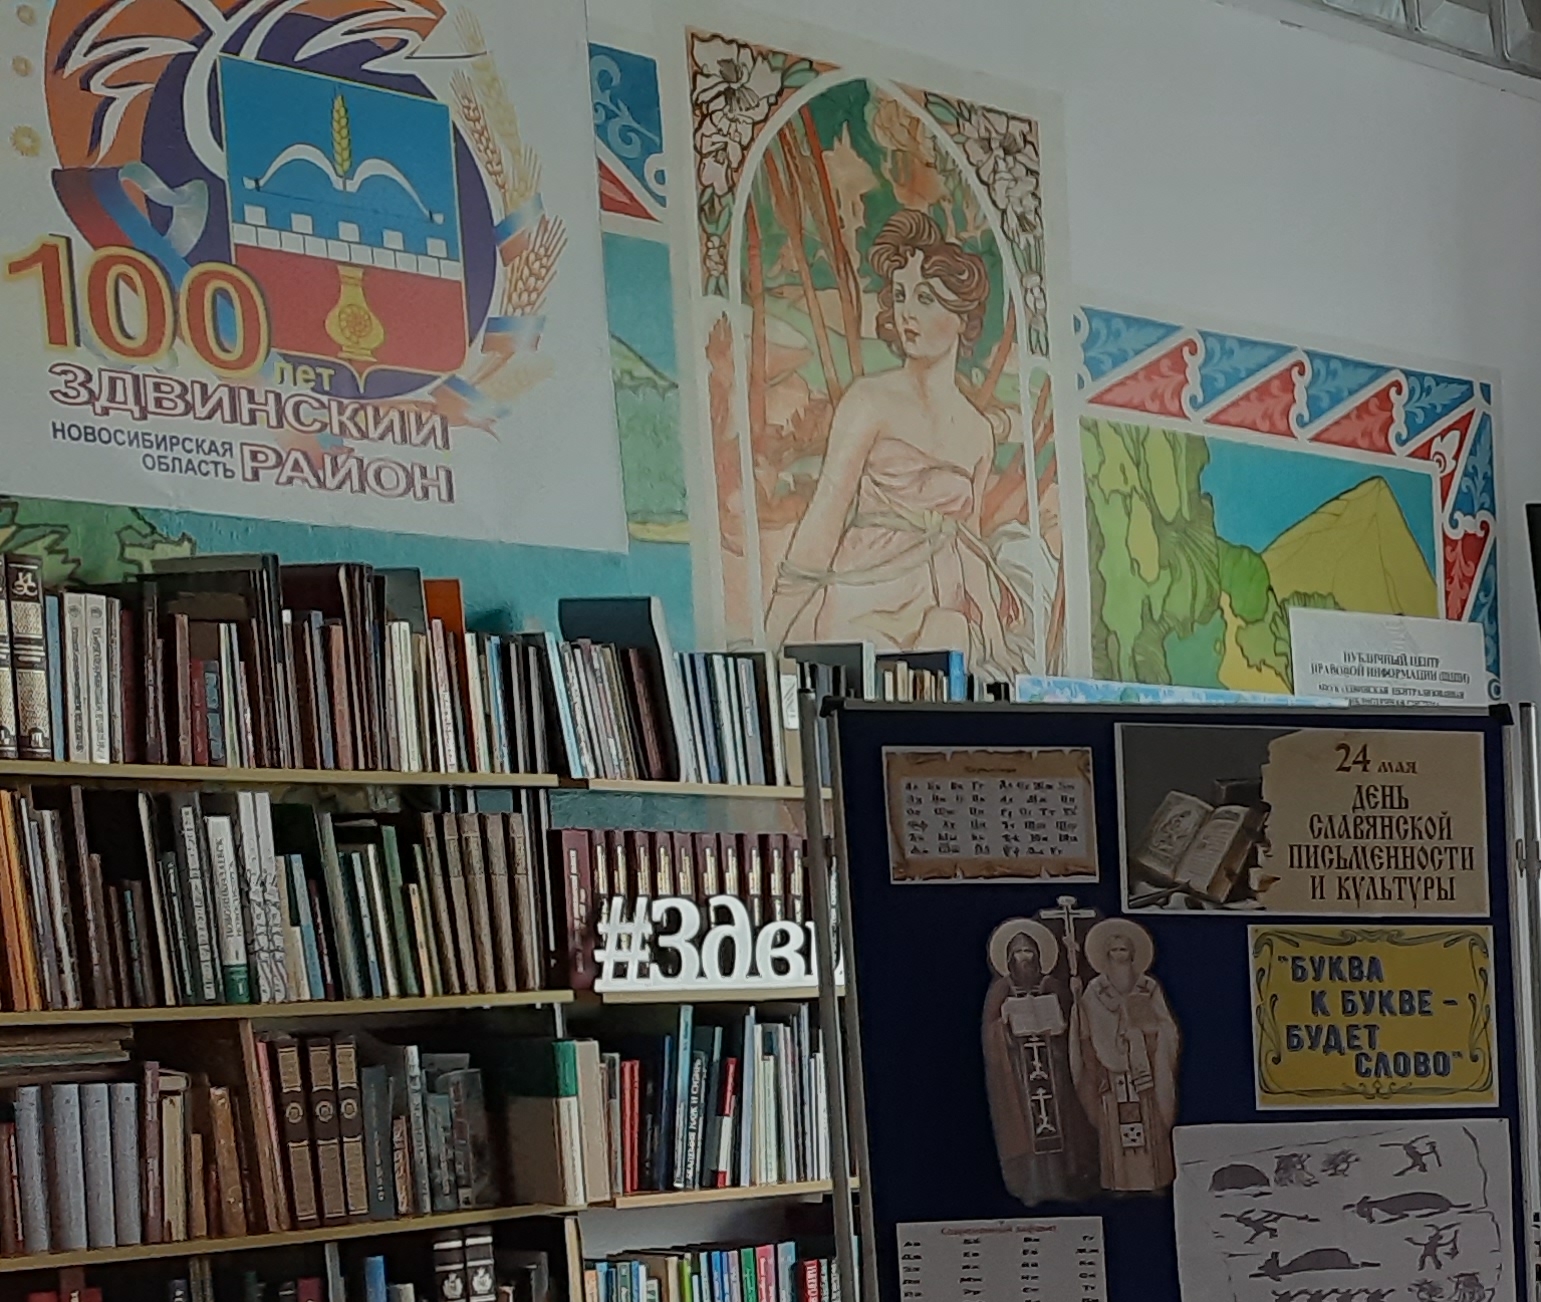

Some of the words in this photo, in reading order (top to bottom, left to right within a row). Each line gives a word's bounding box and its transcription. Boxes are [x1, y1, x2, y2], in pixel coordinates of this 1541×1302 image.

[6, 232, 270, 378] 100
[274, 357, 335, 393] лет
[51, 420, 234, 459] НОВОСИБИРСКАЯ
[142, 452, 236, 481] ОБЛАСТЬ
[241, 436, 455, 503] РАЙОН
[1334, 743, 1372, 775] 24
[1351, 784, 1409, 814] ДЕНЬ
[1309, 811, 1453, 842] СЛАВЯНСКОЙ
[1287, 844, 1475, 874] ПИСЬМЕННОСТИ
[1309, 875, 1327, 901] И
[1336, 873, 1457, 906] КУЛЬТУРЫ
[594, 894, 845, 981] #Здв
[1311, 991, 1331, 1016] К
[1342, 990, 1433, 1017] БУКВЕ
[1286, 1024, 1380, 1054] БУДЕТ
